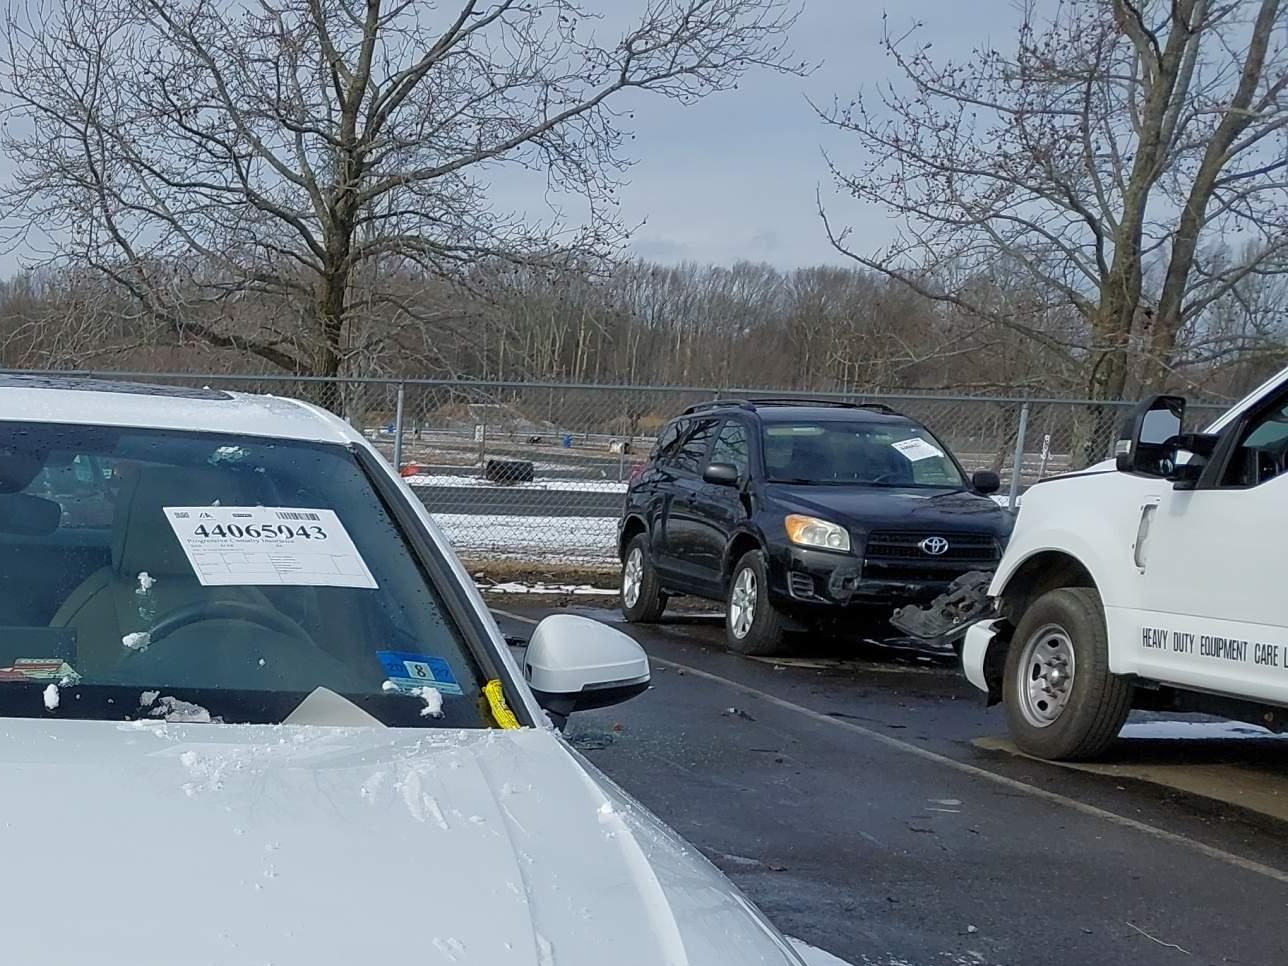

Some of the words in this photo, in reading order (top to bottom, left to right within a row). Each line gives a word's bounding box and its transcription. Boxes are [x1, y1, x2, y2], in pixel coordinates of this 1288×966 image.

[193, 523, 328, 541] 44065043
[1142, 627, 1168, 650] HEAVY
[1173, 631, 1195, 654] DUTY
[1200, 635, 1248, 662] EQUIPMENT
[1254, 643, 1279, 667] CARE
[414, 664, 427, 678] 8
